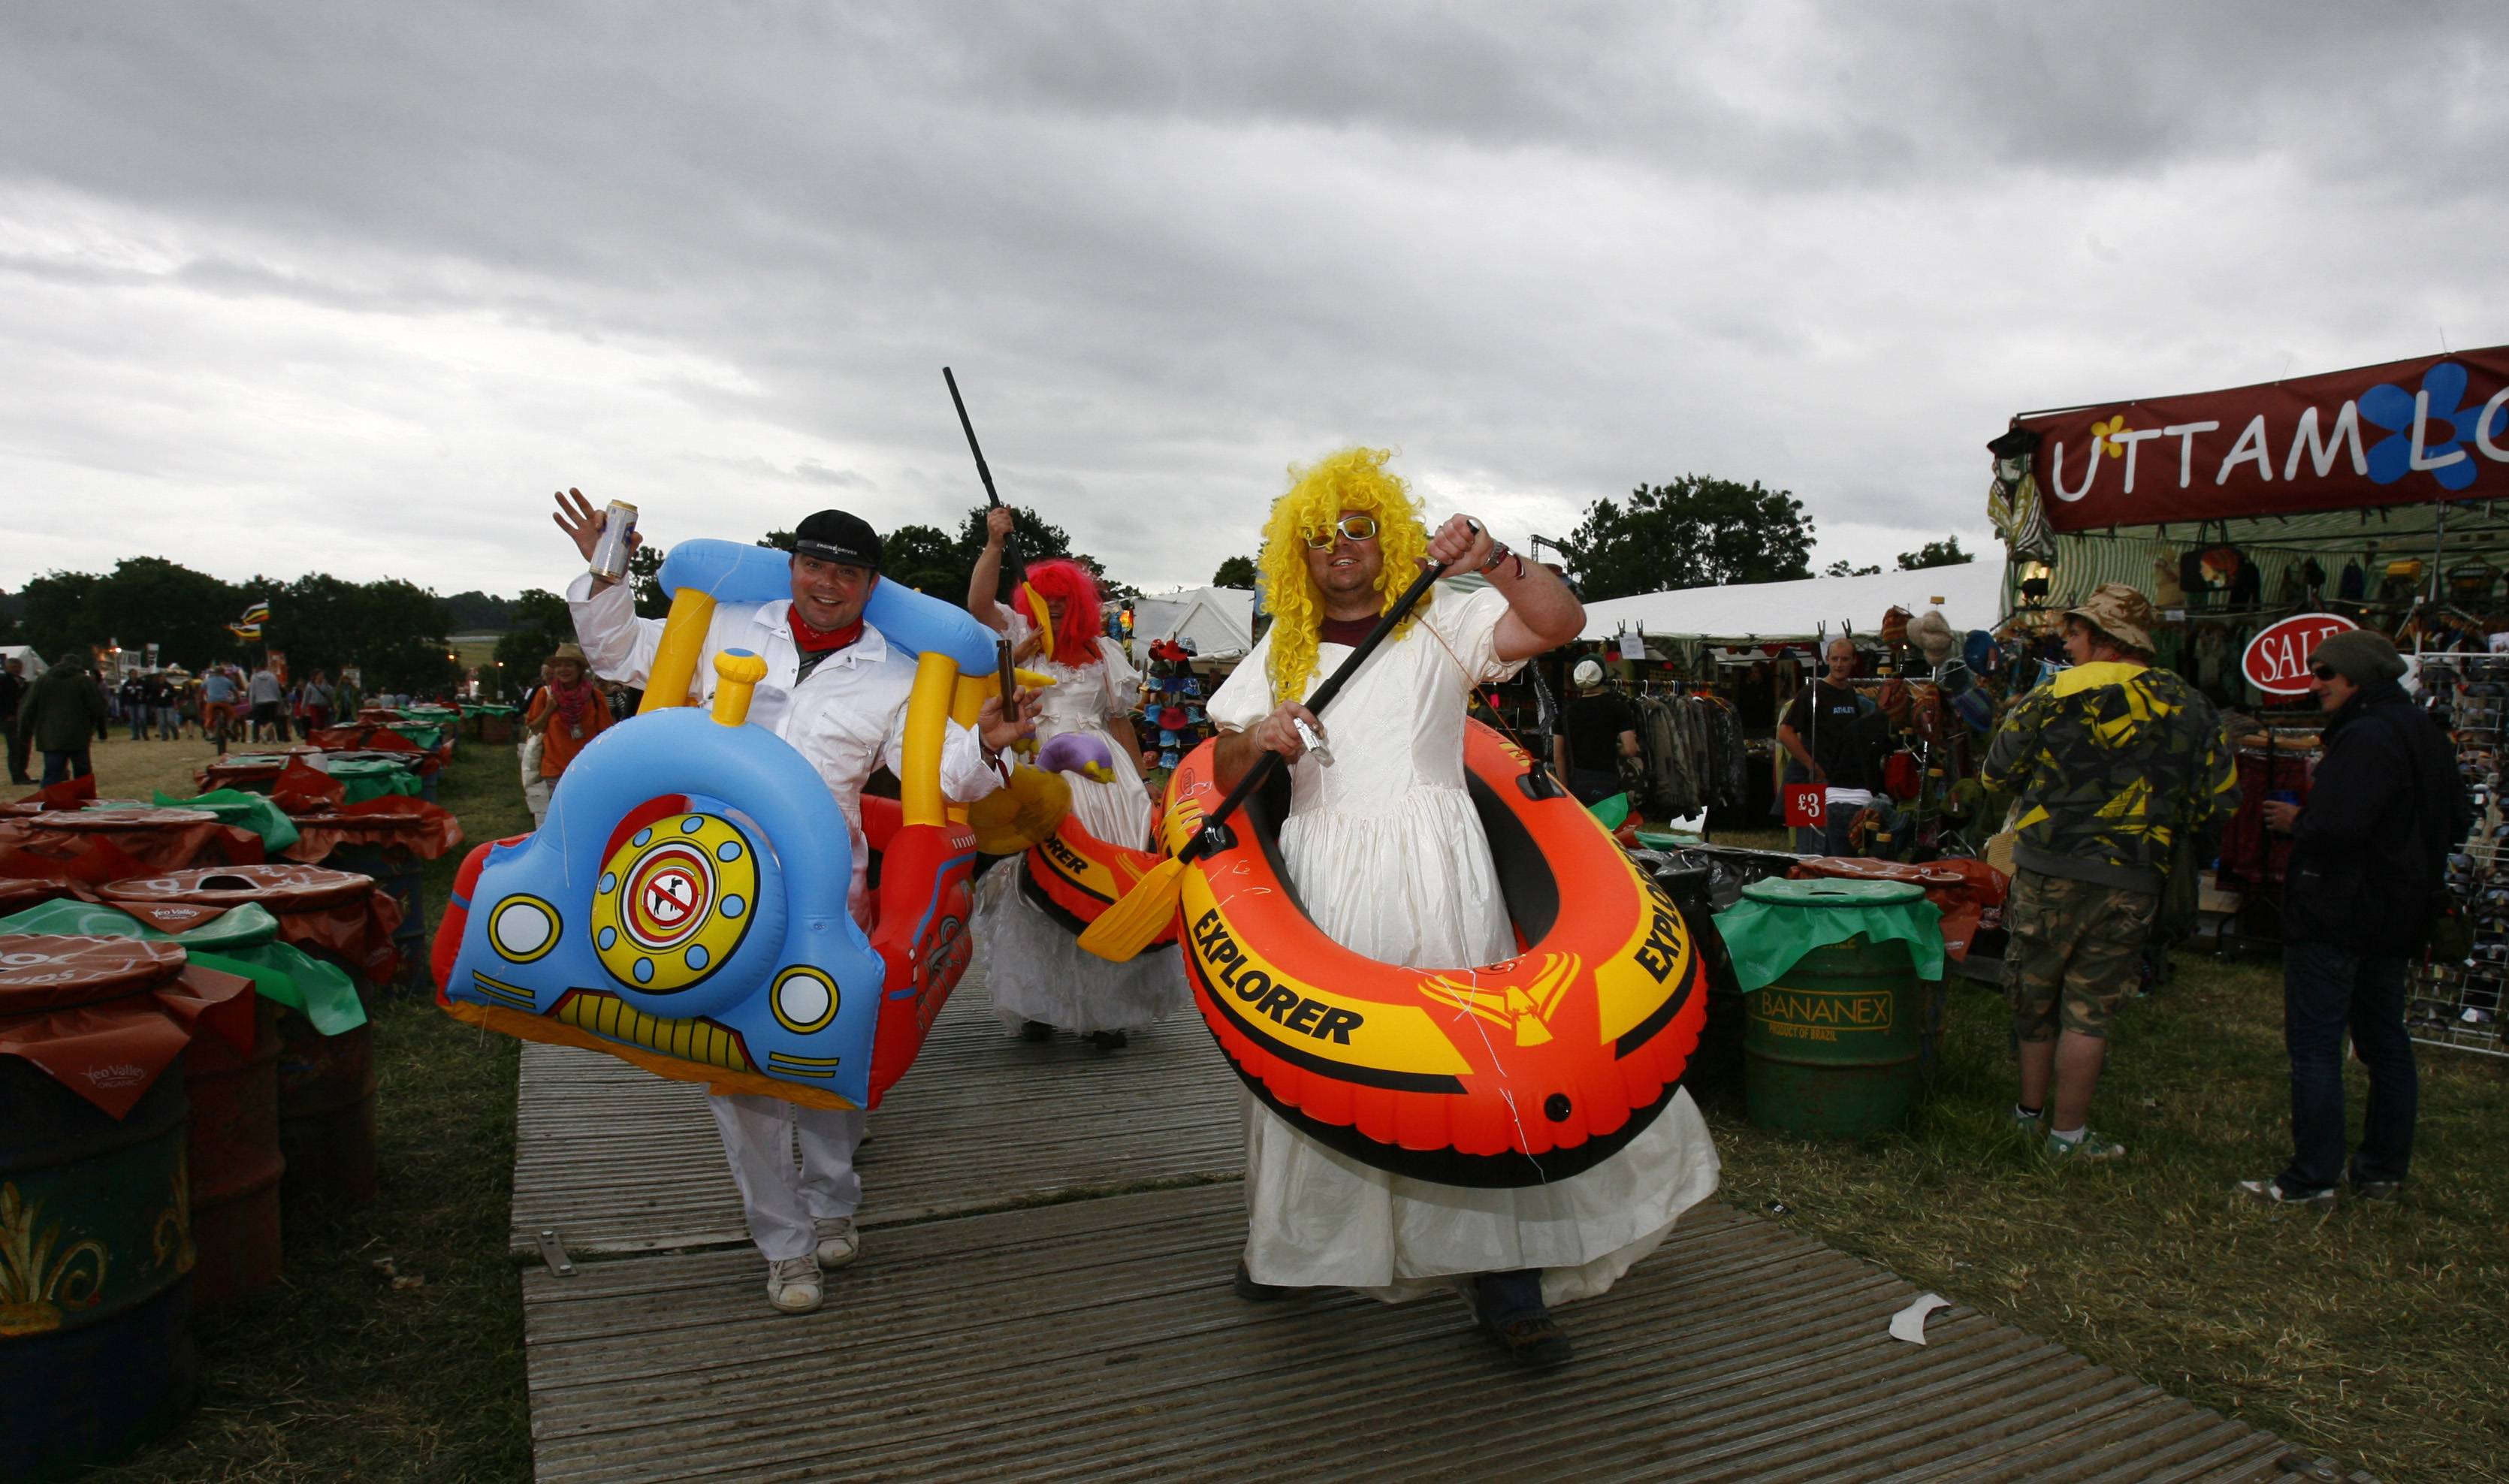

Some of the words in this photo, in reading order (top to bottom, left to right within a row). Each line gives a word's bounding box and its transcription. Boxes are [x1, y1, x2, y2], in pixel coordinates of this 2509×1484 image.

[2052, 400, 2368, 502] UTTAM
[2260, 626, 2338, 682] SAL
[1798, 792, 1820, 818] £3
[1193, 907, 1364, 1045] EXPLORER
[1762, 991, 1888, 1024] BANANEX
[78, 1064, 109, 1085] Yeo
[108, 1063, 148, 1081] Valley
